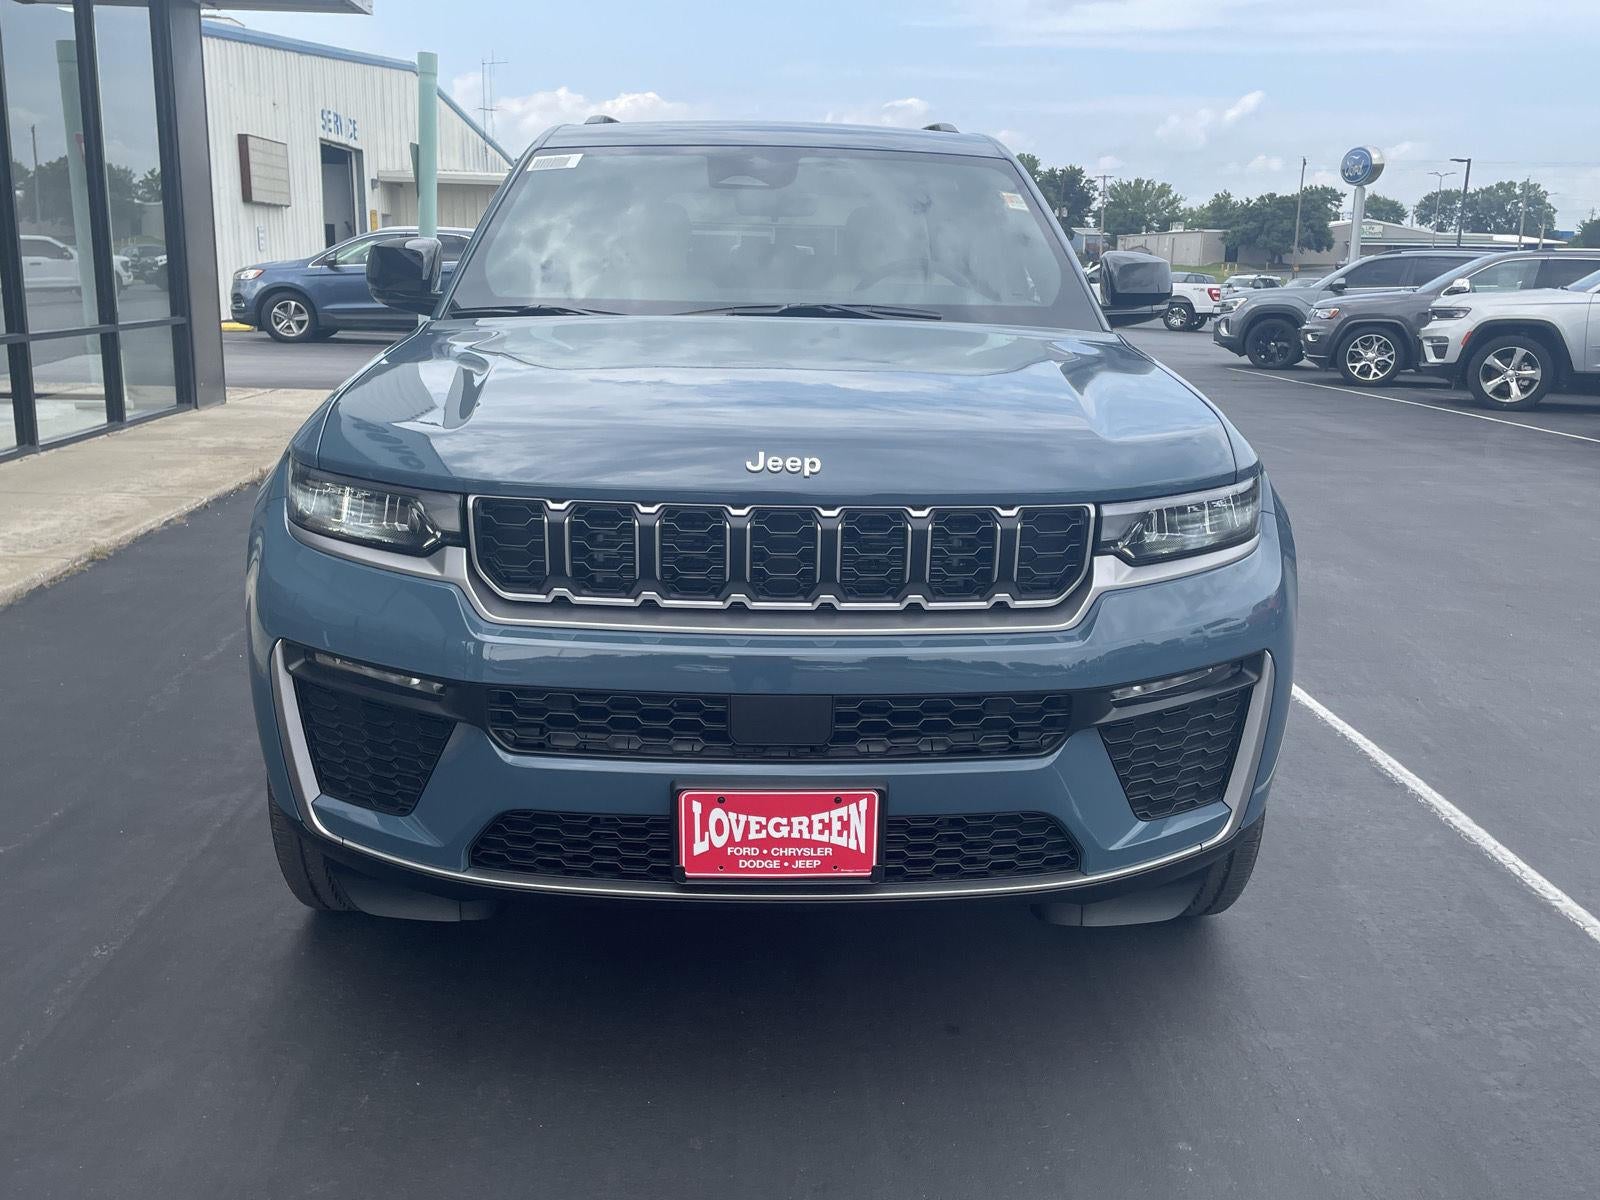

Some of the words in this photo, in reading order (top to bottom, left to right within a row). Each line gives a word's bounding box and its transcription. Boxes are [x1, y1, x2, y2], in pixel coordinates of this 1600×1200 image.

[320, 109, 358, 141] SERVCE
[1344, 154, 1366, 178] Ford
[745, 451, 822, 479] Jeep
[692, 797, 868, 857] LOVEGREEN
[727, 846, 760, 857] FORD
[770, 846, 833, 857] CHRYSLER
[738, 859, 781, 869] DODGE
[791, 859, 822, 869] JEEP
